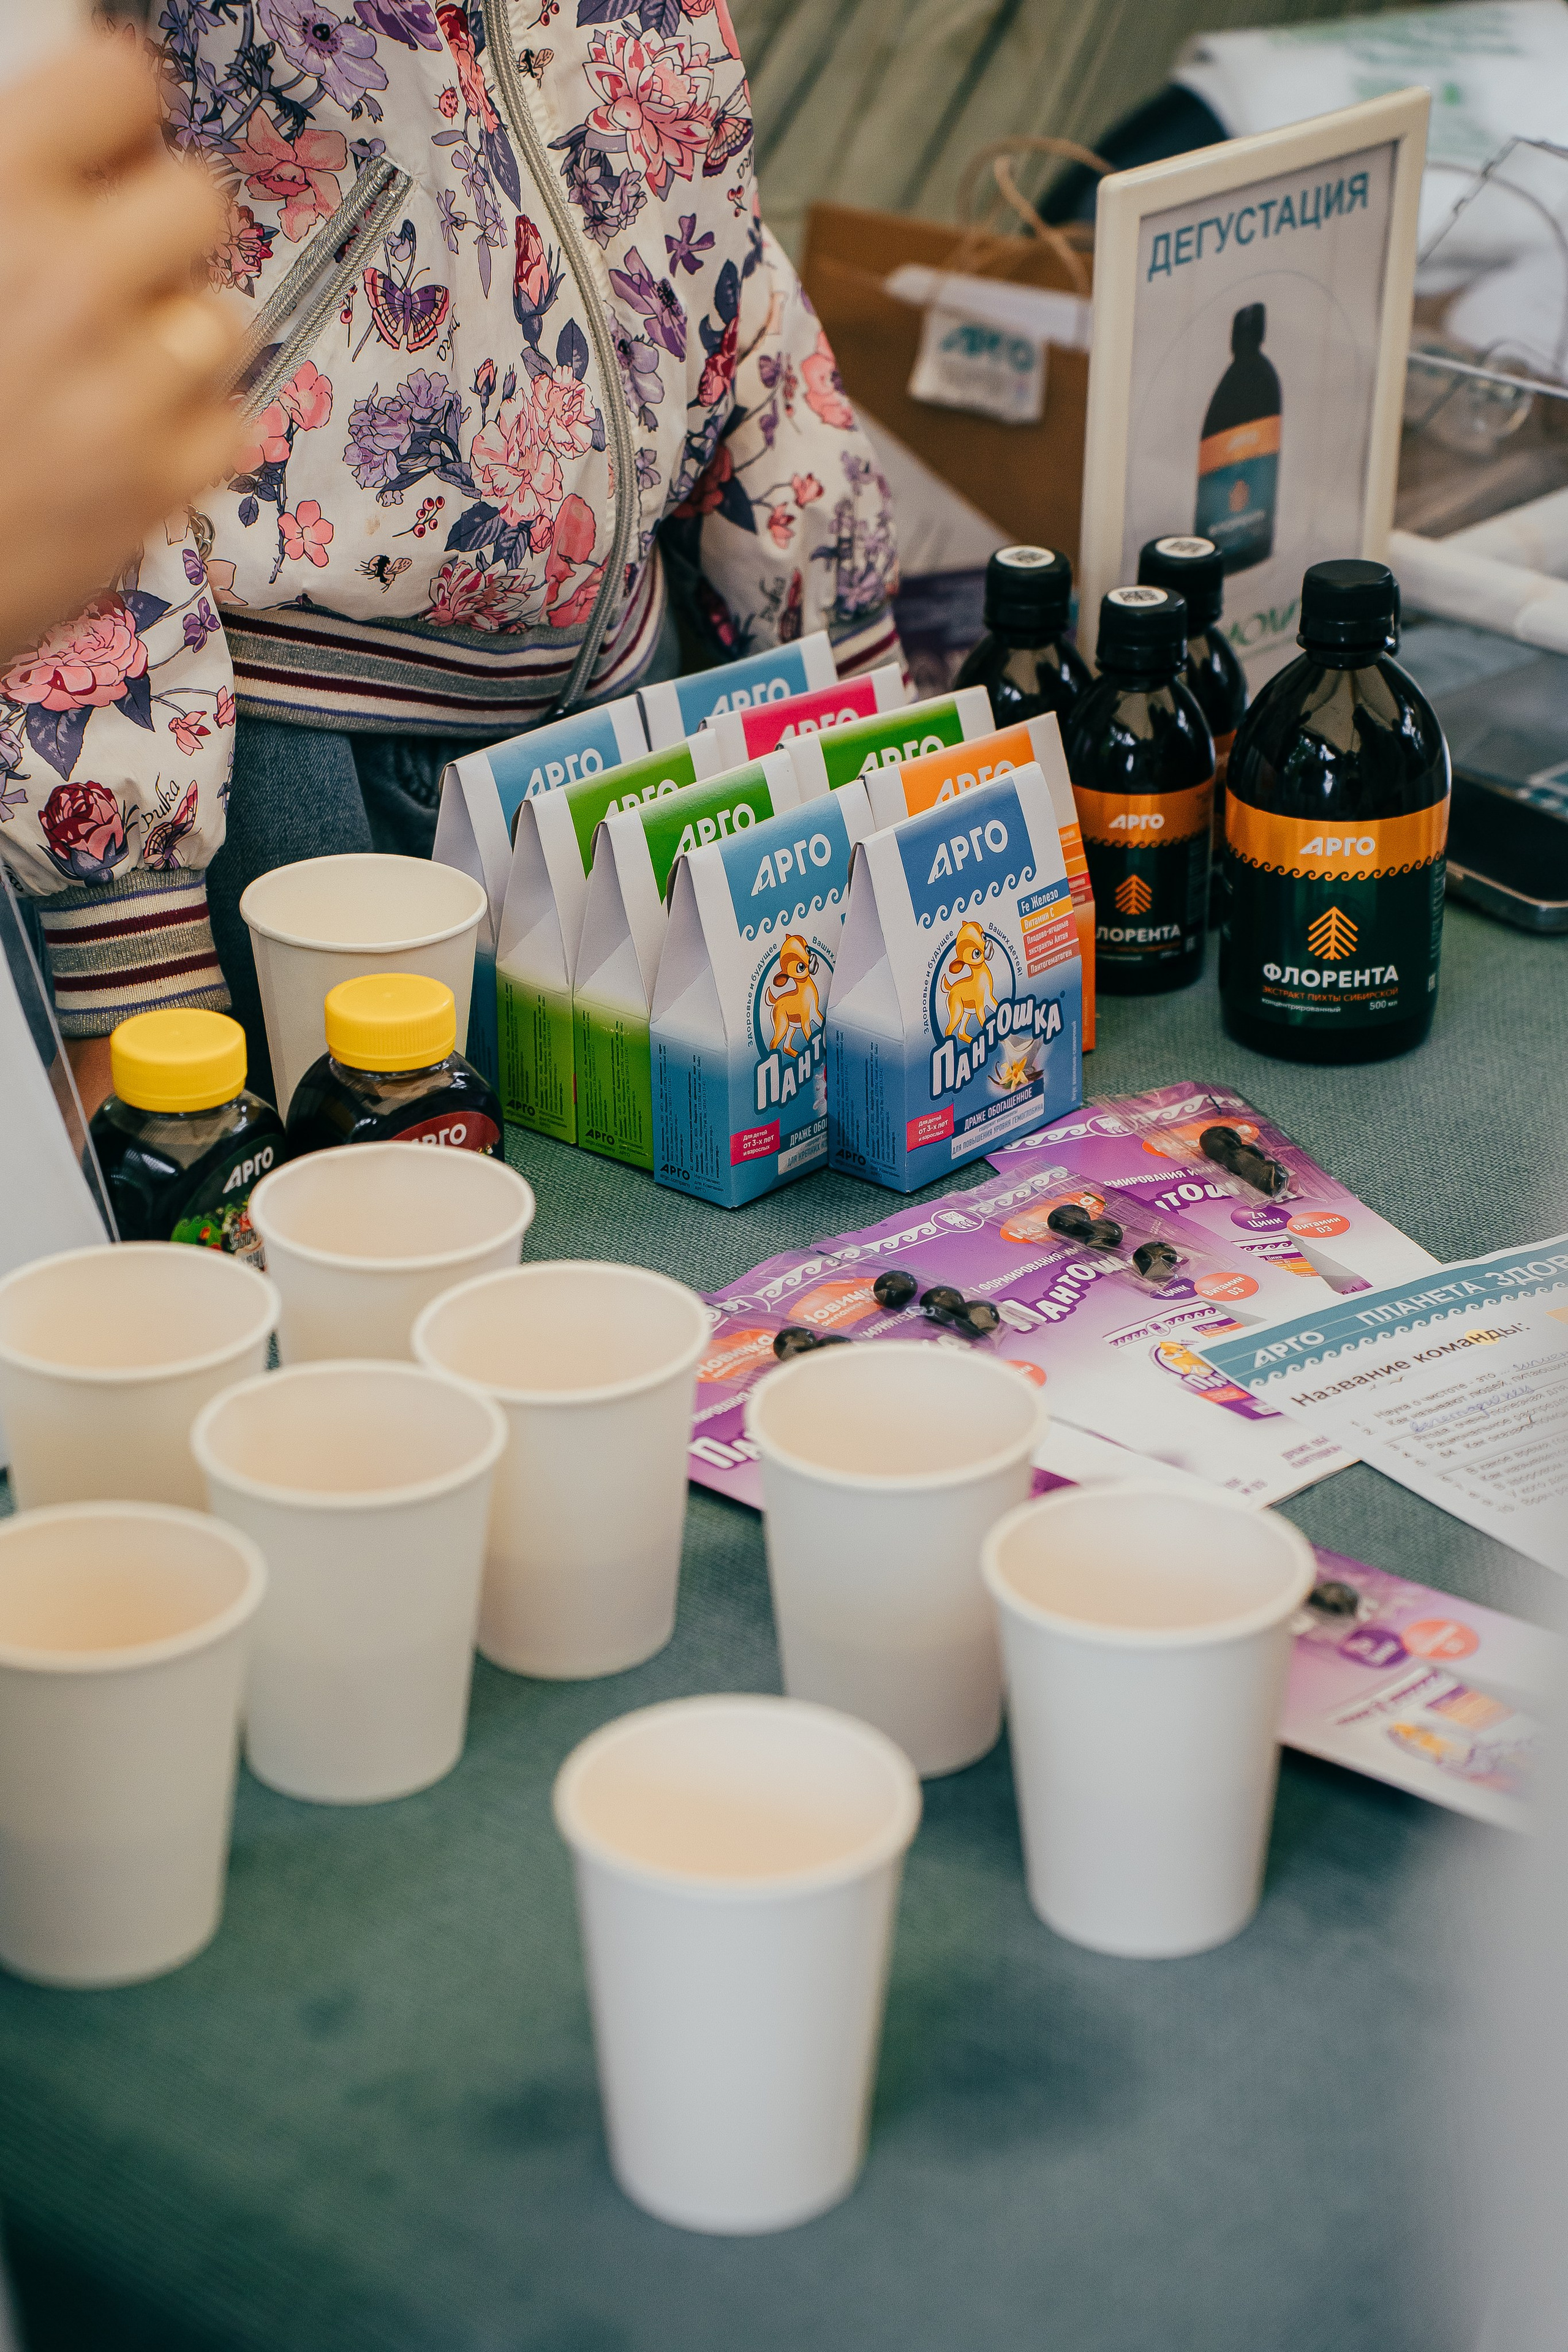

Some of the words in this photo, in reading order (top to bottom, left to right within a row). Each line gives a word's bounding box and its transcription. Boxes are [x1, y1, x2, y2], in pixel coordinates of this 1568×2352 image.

[1147, 172, 1370, 282] ДЕГУСТАЦИЯ
[710, 678, 791, 717] АРГО
[859, 736, 945, 777] АРГО
[524, 748, 604, 798] АРГО
[1108, 813, 1165, 829] АРГО
[673, 804, 756, 865] АРГО
[927, 820, 1008, 884] АРГО
[1299, 836, 1376, 857] АРГО
[750, 833, 832, 897] АРГО
[1021, 901, 1030, 912] Fe
[1031, 889, 1059, 908] Железо
[1023, 913, 1049, 930] Витамин
[1027, 919, 1069, 945] Плодово-ягодные
[1028, 939, 1054, 956] экстракты
[1054, 932, 1069, 944] Алтая
[1096, 924, 1181, 943] ЛОРЕНТА
[751, 943, 777, 982] будущее
[812, 936, 835, 960] Ваших
[928, 930, 954, 968] будущее
[989, 922, 1010, 945] Ваших
[1008, 944, 1023, 976] детей!
[1030, 949, 1072, 974] Пантогематоген
[1262, 962, 1399, 989] ФЛОРЕНТА
[1262, 985, 1305, 1000] ЭКСТРАКТ
[1308, 993, 1341, 1002] ПИХТЫ
[1343, 987, 1399, 1002] СИБИРСКОЙ
[1261, 997, 1341, 1013] концентрированный
[1370, 1000, 1386, 1011] 500
[758, 1034, 826, 1110] ПАНТ
[507, 1099, 536, 1117] АРГО
[964, 1110, 986, 1132] ДРАЖЕ
[988, 1087, 1033, 1118] ОБОГАЩЕННОЕ
[928, 1115, 942, 1125] детей
[937, 1120, 949, 1129] лет
[585, 1129, 615, 1145] АРГО
[753, 1129, 768, 1139] детей
[763, 1134, 774, 1145] лет
[790, 1126, 812, 1148] ДРАЖЕ
[922, 1130, 944, 1140] взрослых
[952, 1144, 962, 1156] ДЛЯ
[963, 1129, 993, 1149] ПОВЫШЕНИЯ
[993, 1121, 1011, 1135] УРОВНЯ
[747, 1145, 770, 1156] взрослых
[835, 1148, 866, 1166] АРГО
[222, 1146, 274, 1194] АРГО
[660, 1164, 690, 1180] АРГО
[1102, 1170, 1185, 1188] РМИРОВАНИЯ
[1247, 1217, 1284, 1229] Цинк
[1292, 1217, 1341, 1231] Витамин
[978, 1251, 1066, 1291] ФОРМИРОВАНИЯ
[998, 1258, 1133, 1332] ПАНТОШ
[1156, 1284, 1191, 1298] Цинк
[1201, 1276, 1246, 1297] Витамин
[1226, 1287, 1245, 1296] D3
[1254, 1332, 1325, 1368] АРГО
[1356, 1281, 1487, 1327] ПЛАНЕТА
[1485, 1254, 1568, 1286] ЗДОР
[1289, 1359, 1411, 1409] Название
[1416, 1322, 1531, 1365] команды:
[1373, 1404, 1411, 1419] Наука
[1420, 1383, 1468, 1402] чистоте
